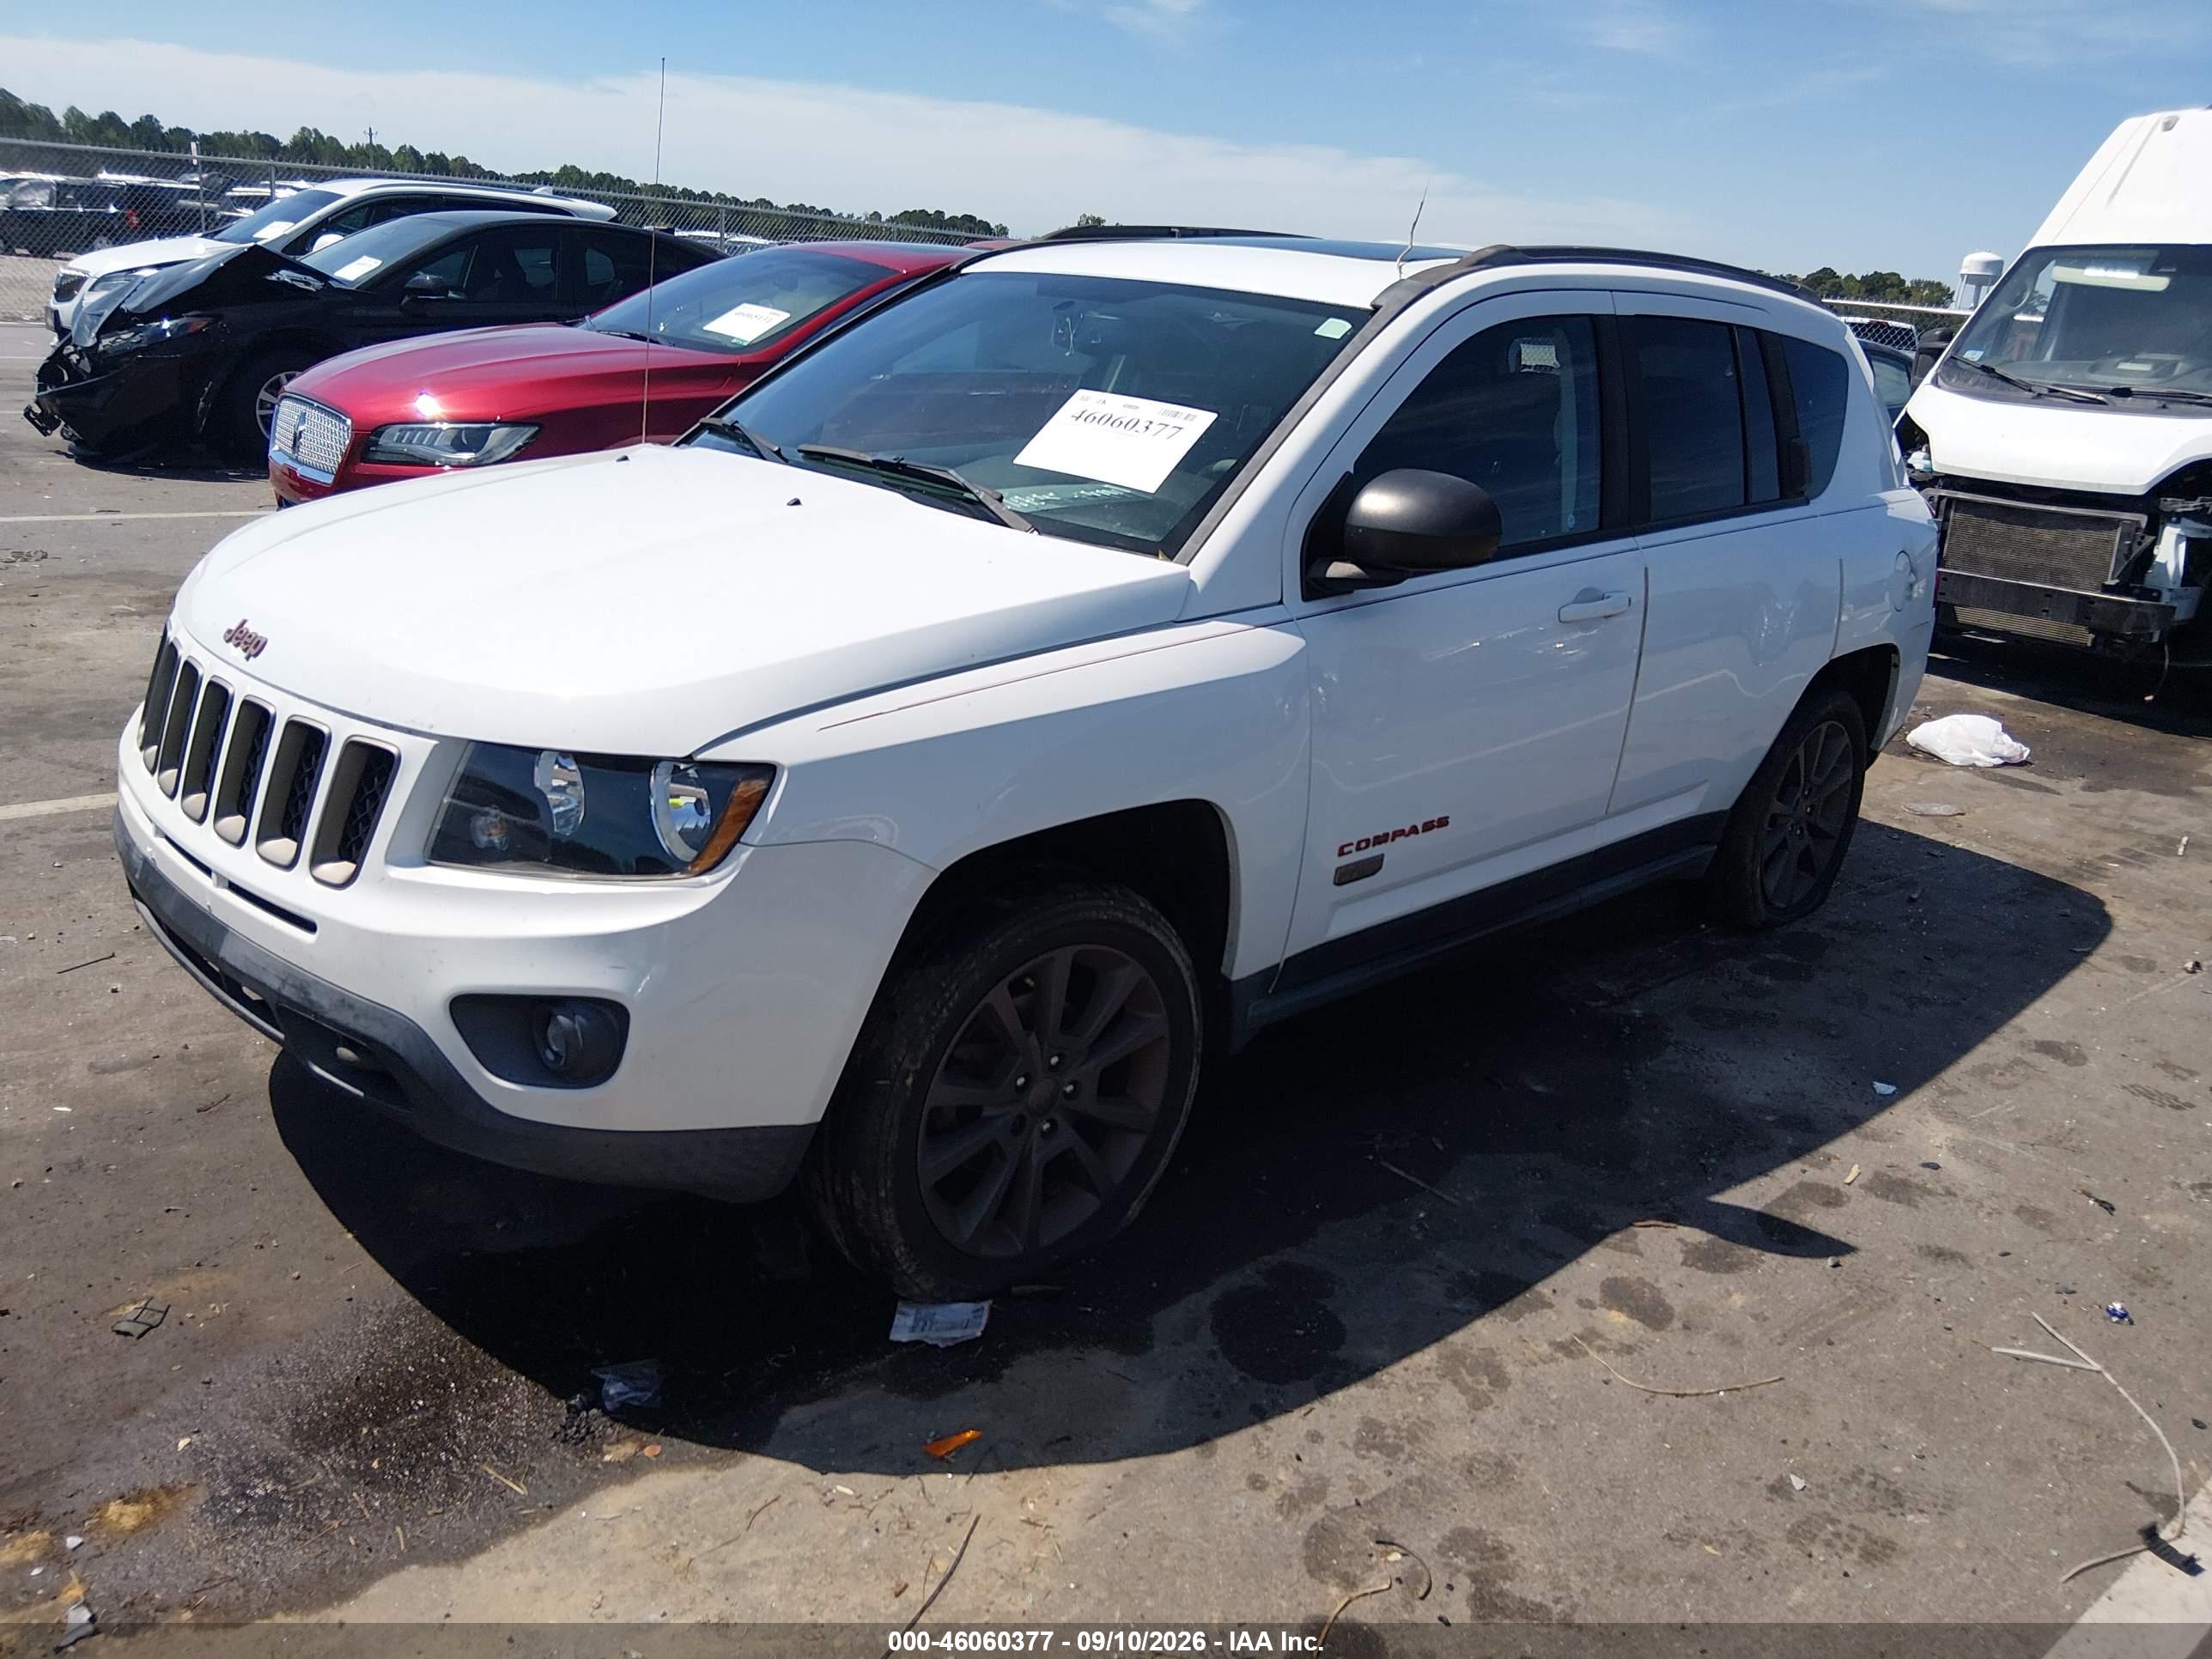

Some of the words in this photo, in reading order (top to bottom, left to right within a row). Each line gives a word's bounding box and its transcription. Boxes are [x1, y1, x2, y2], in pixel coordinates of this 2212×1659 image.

[1071, 409, 1184, 440] 46060377
[223, 618, 268, 662] Jeep
[1337, 816, 1450, 857] COMPASS
